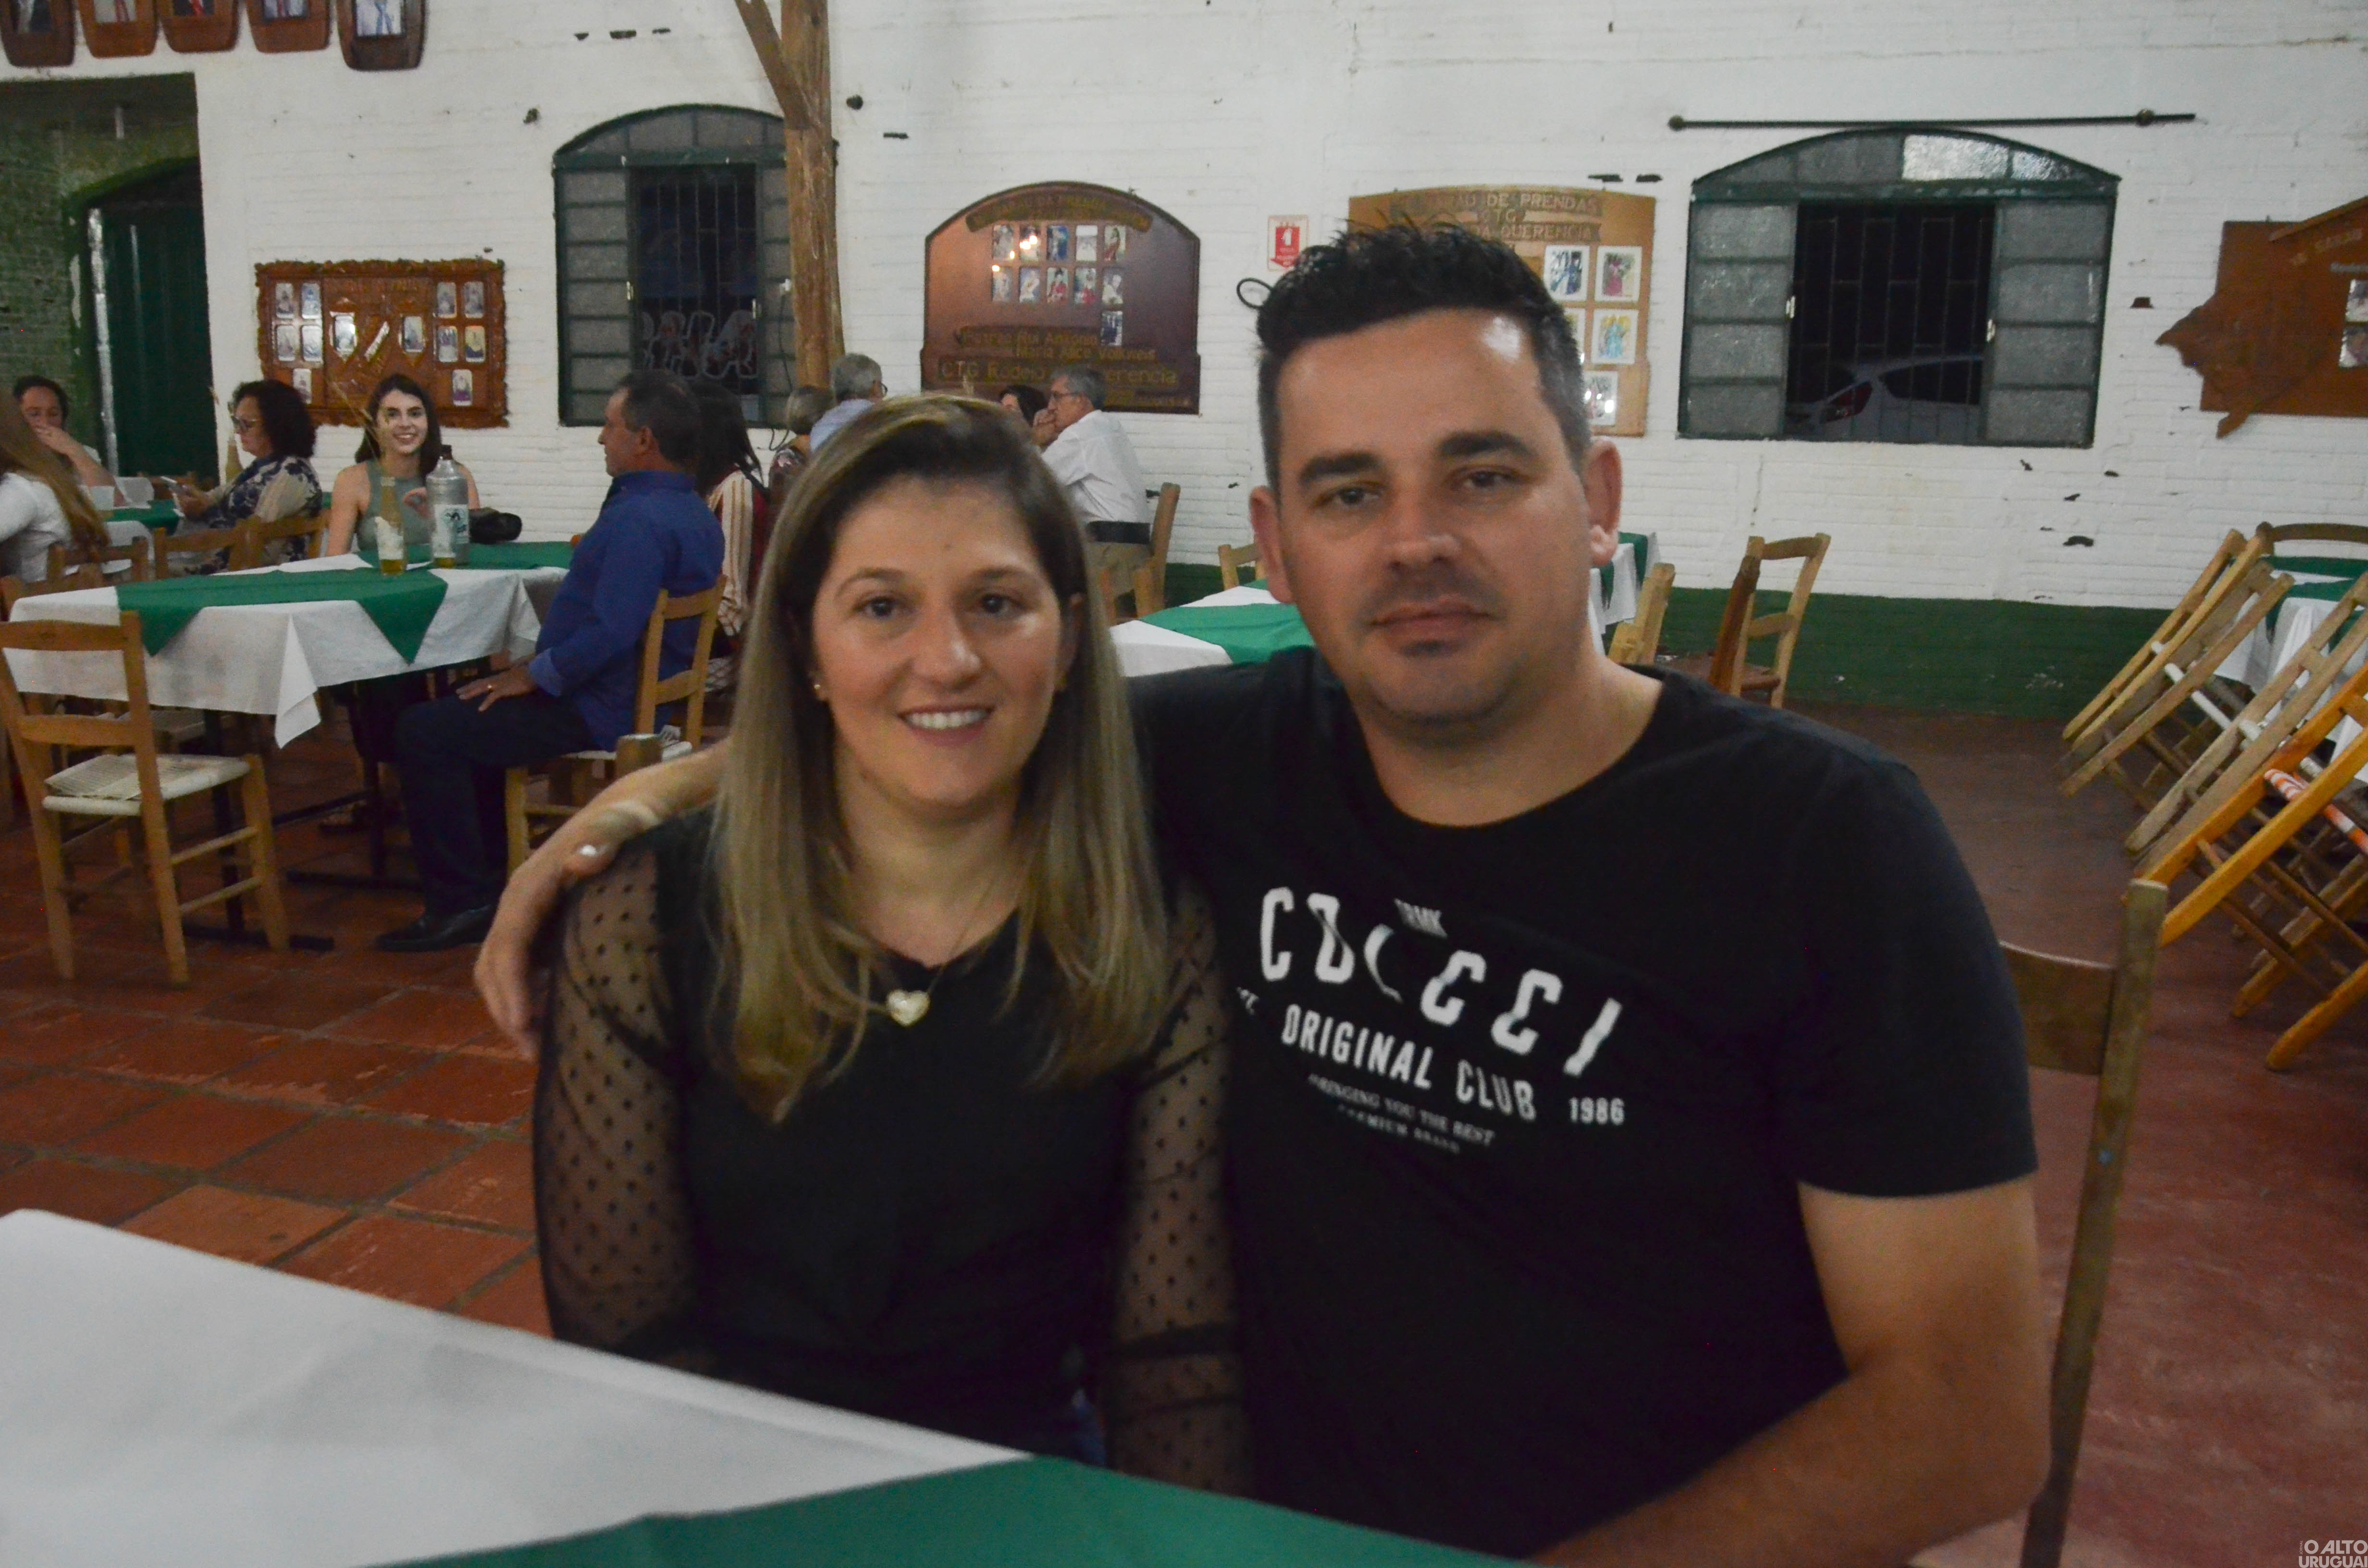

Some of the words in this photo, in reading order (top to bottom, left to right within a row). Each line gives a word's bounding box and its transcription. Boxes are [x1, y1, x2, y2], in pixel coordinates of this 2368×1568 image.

[1487, 193, 1509, 208] DE
[1520, 193, 1597, 213] PRENDAS
[942, 360, 979, 379] CTG
[1104, 368, 1177, 384] erencia
[1281, 1004, 1434, 1089] ORIGINAL
[1455, 1059, 1537, 1122] CLUB
[1569, 1097, 1626, 1126] 1986
